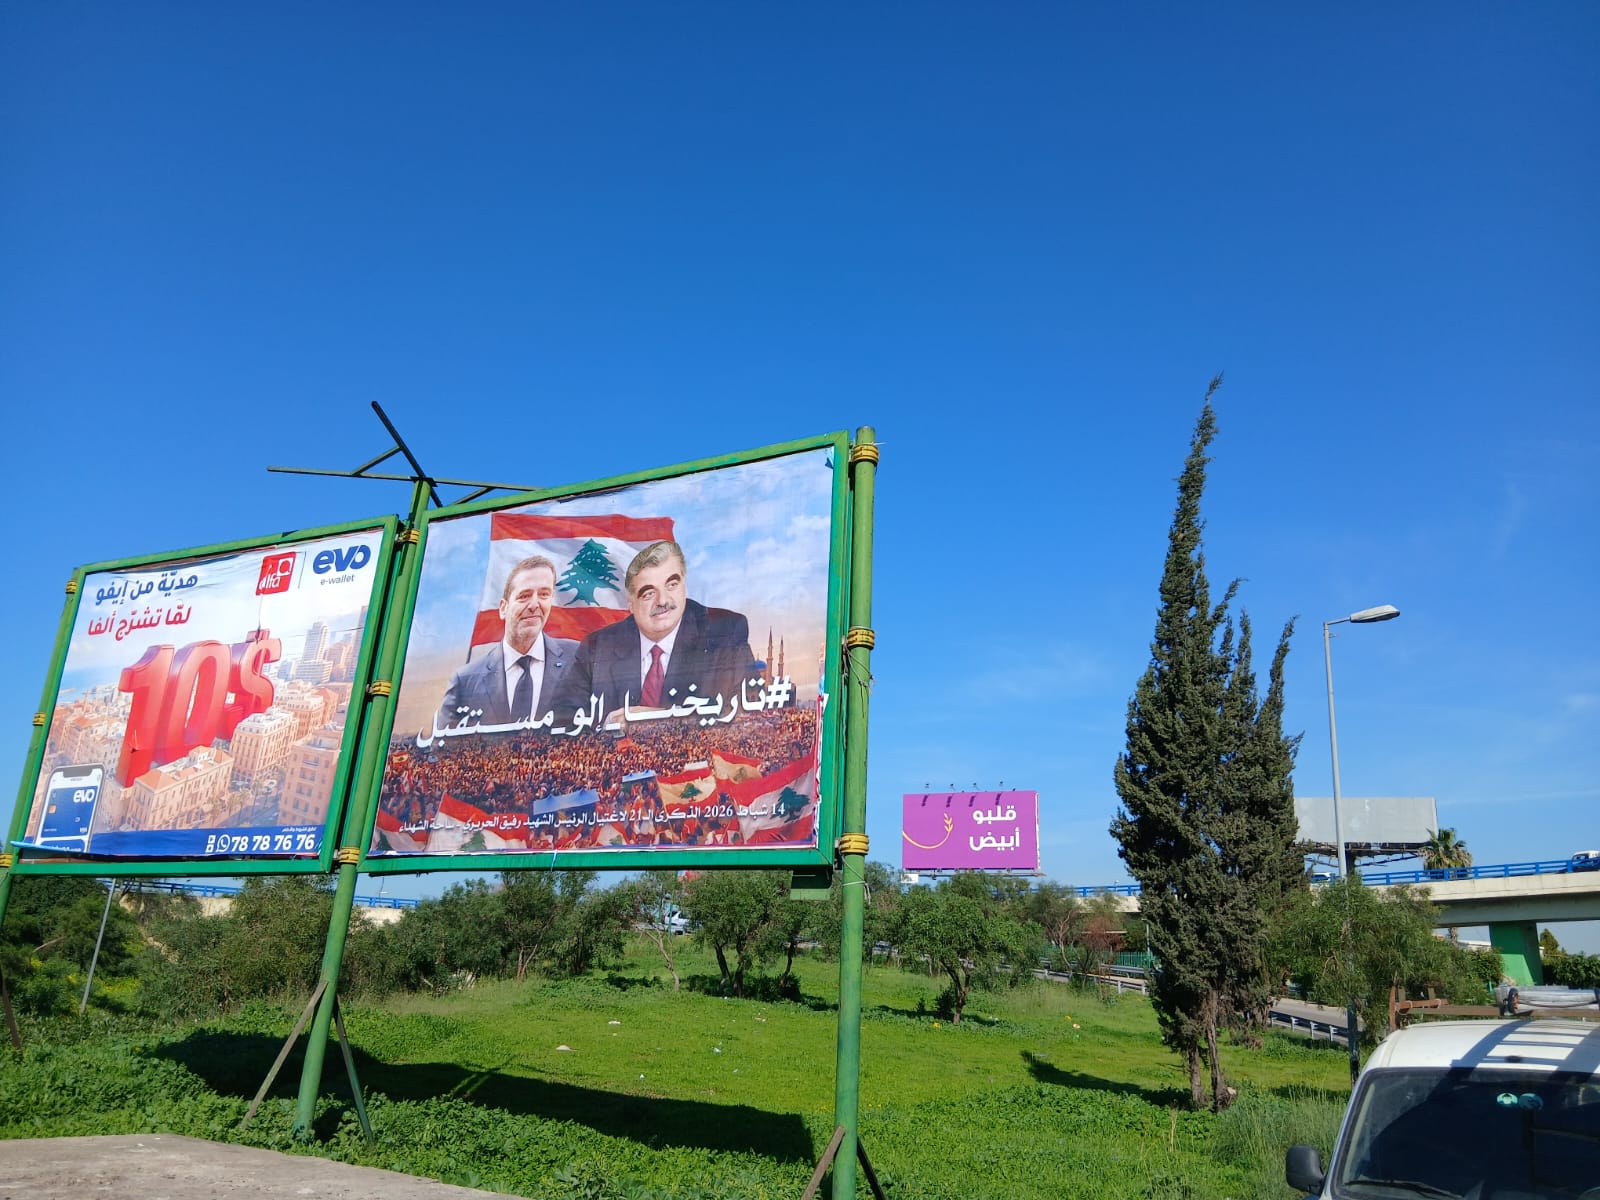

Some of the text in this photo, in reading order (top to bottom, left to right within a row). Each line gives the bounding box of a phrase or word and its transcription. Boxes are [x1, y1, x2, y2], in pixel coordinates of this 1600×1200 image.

[313, 544, 371, 575] evo
[320, 574, 355, 586] e-wallet
[95, 580, 127, 606] إيفو
[130, 580, 154, 601] من
[87, 610, 117, 636] ألفا
[117, 628, 283, 788] 10$
[73, 789, 95, 803] evo
[555, 811, 588, 827] الرئيس
[588, 808, 627, 826] لاغتيال
[654, 807, 701, 823] الذكرى
[704, 805, 733, 818] 2026
[736, 803, 768, 820] شباط
[772, 804, 786, 816] 14
[972, 804, 1017, 825] قلبو
[462, 816, 500, 834] الحريري
[499, 817, 522, 831] رفيق
[523, 813, 554, 828] الشهيد
[231, 834, 316, 852] 78 78 76 76
[969, 827, 1021, 852] أبيض
